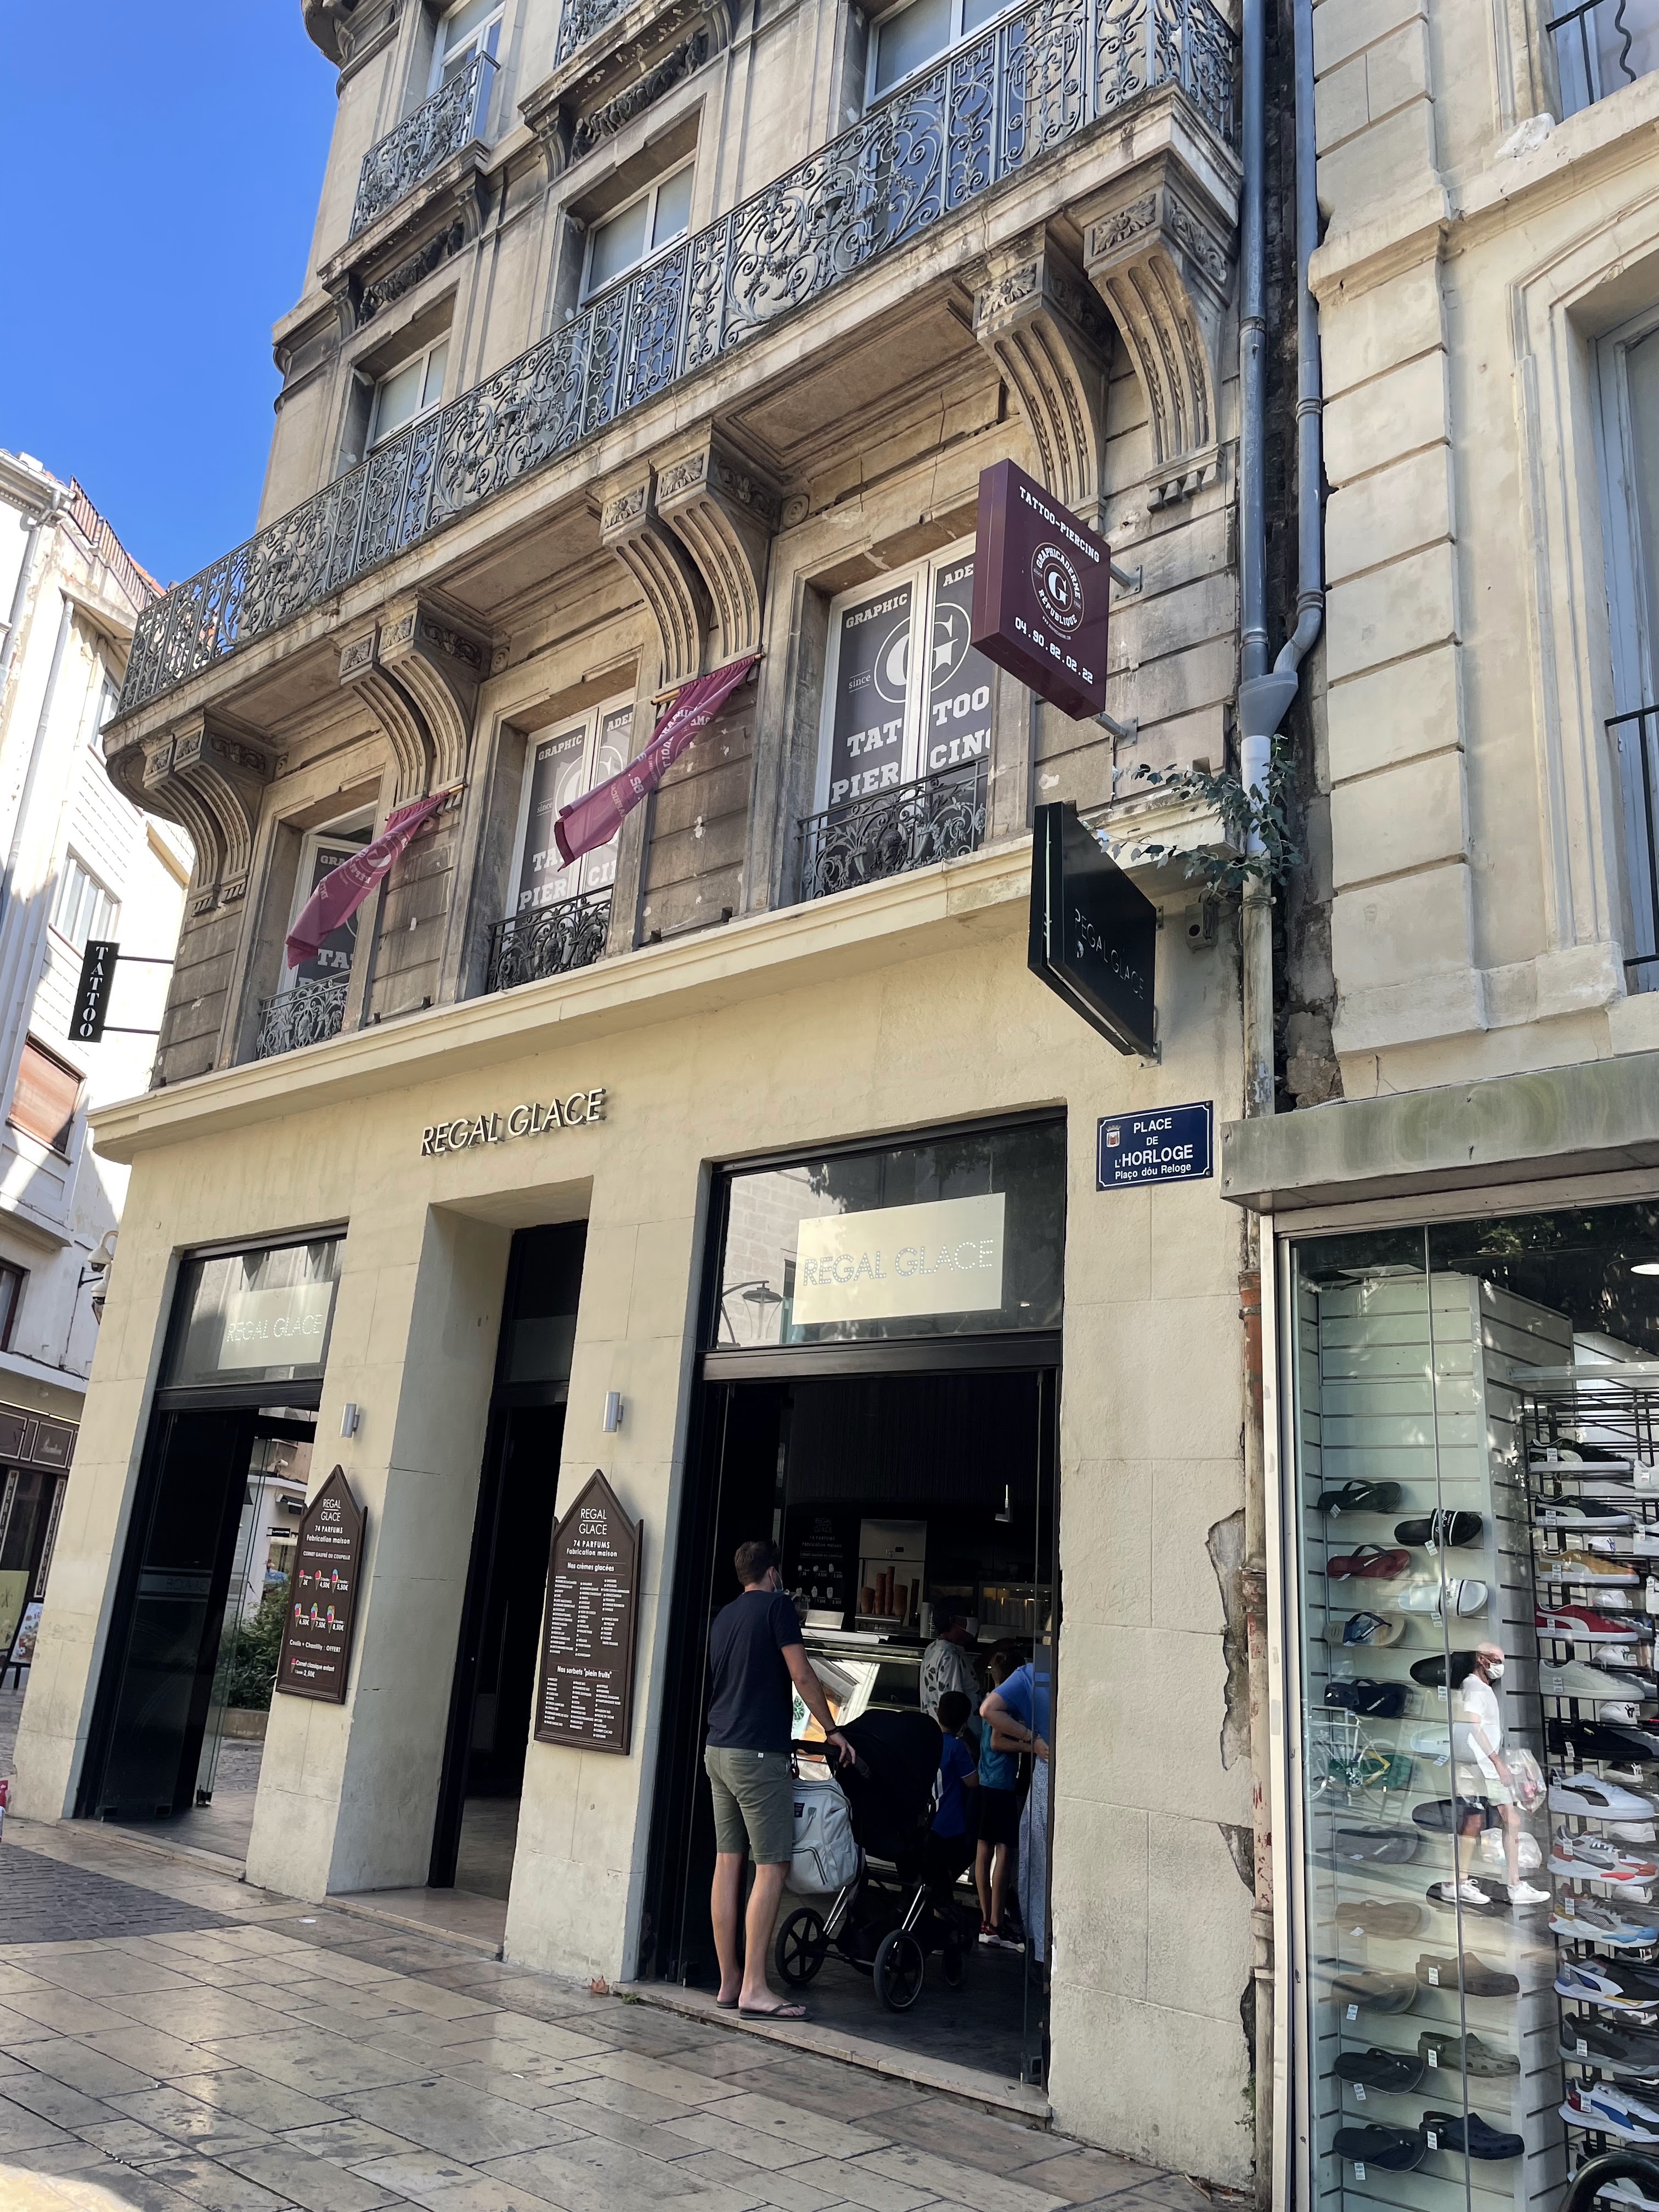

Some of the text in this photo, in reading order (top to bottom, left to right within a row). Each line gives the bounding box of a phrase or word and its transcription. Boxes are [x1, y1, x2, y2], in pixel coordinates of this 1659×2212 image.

[1019, 486, 1099, 563] TATTOO-PIERCING
[1036, 548, 1081, 600] GRAPHICADERME
[1048, 571, 1068, 606] G
[846, 593, 908, 629] GRAPHIC
[848, 673, 871, 690] since
[847, 685, 990, 758] TAT TOO
[538, 735, 583, 761] GRAPHIC
[831, 761, 899, 805] PIER
[537, 802, 553, 813] since
[533, 847, 564, 872] TA
[518, 878, 567, 911] PIER
[1111, 949, 1144, 1000] GLACE
[80, 946, 109, 1037] TATTOO
[420, 1087, 606, 1156] REGAL GLACE
[1133, 1118, 1172, 1133] PLACE
[1146, 1136, 1159, 1146] DE
[1115, 1144, 1193, 1169] L'HORLOGE
[1115, 1171, 1138, 1181] Plaço
[1161, 1164, 1191, 1174] Reloge
[803, 1239, 994, 1286] REGAL GLACE
[227, 1314, 323, 1342] REGAL GLACE
[321, 1511, 341, 1522] GLACE
[323, 1499, 341, 1509] REGAL
[580, 1508, 607, 1520] REGAL
[321, 1526, 343, 1534] PARFUMS
[579, 1523, 607, 1535] GLACE
[582, 1541, 610, 1549] PARFUMS
[566, 1667, 583, 1675] sorbets
